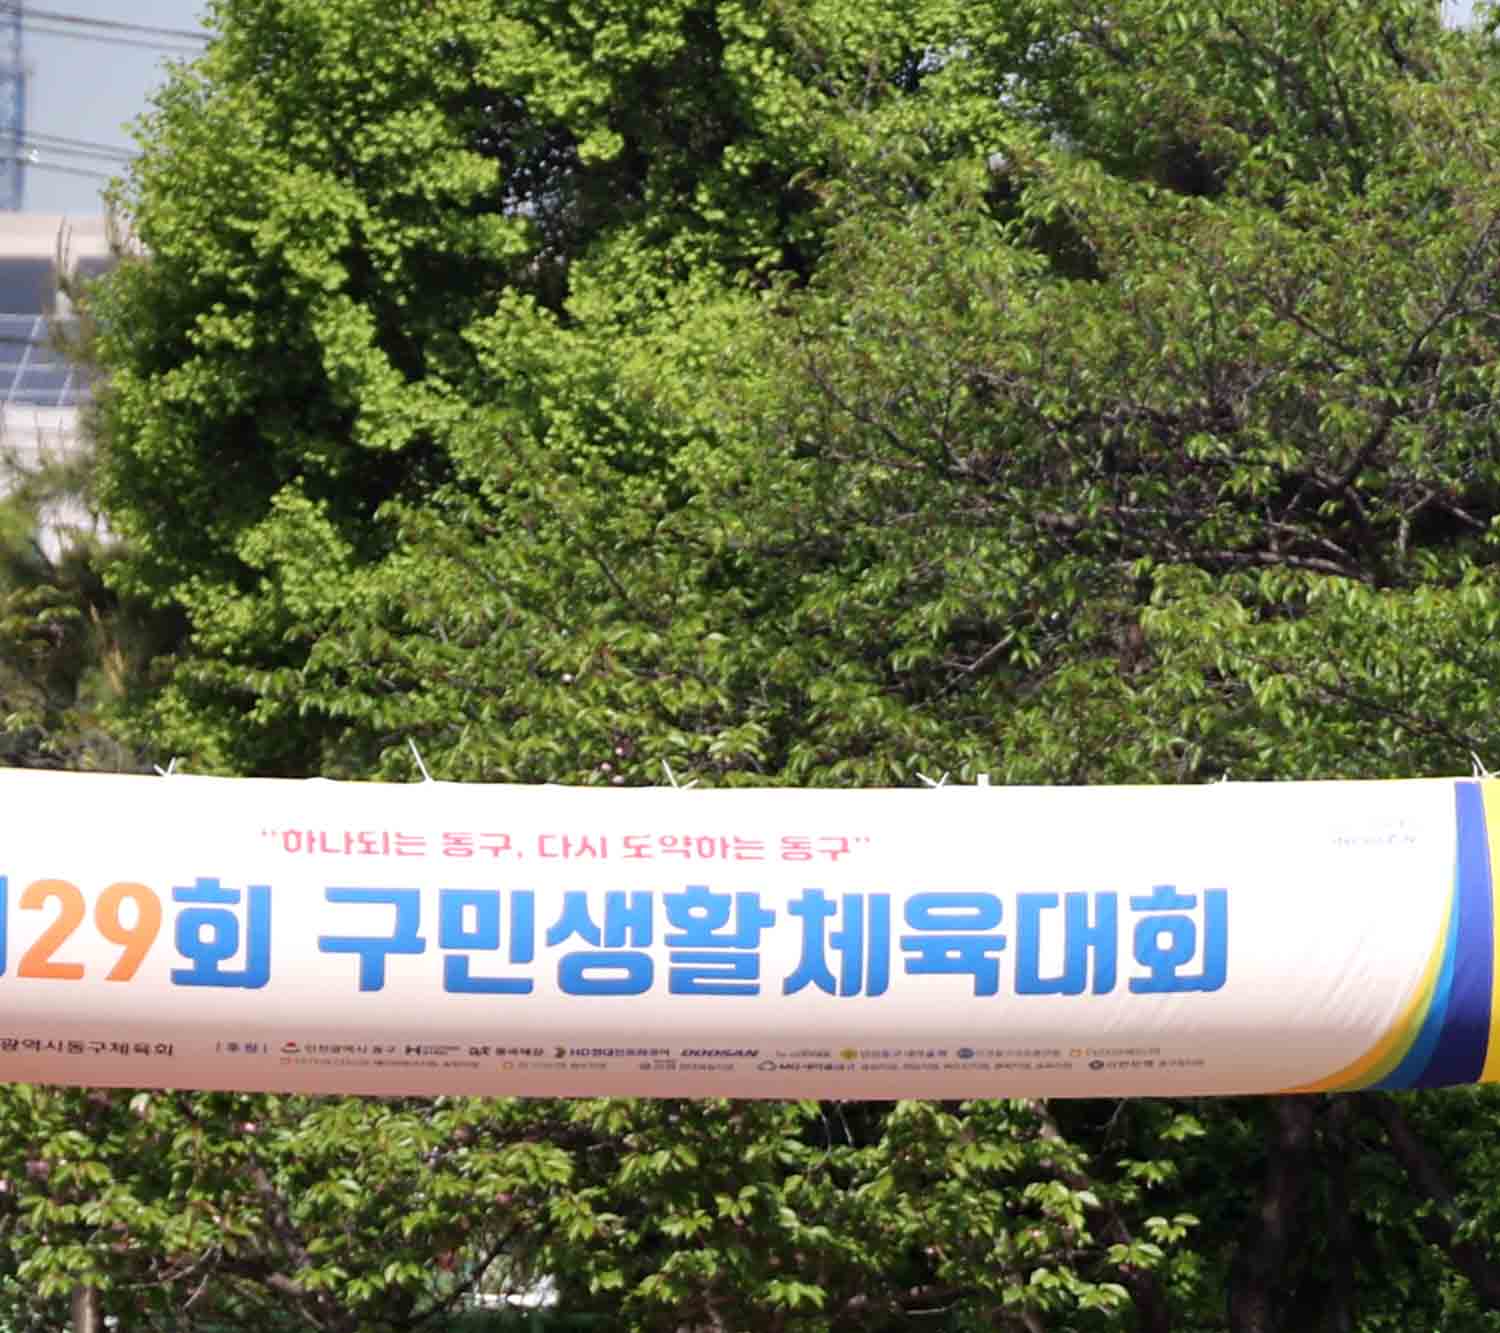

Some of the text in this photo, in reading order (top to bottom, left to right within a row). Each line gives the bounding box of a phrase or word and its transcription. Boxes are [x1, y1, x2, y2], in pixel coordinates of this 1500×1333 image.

[441, 831, 525, 861] 동구,
[537, 832, 609, 860] 다시
[622, 833, 767, 862] 도약하는
[0, 875, 1228, 998] 29회 구민생활체육대회
